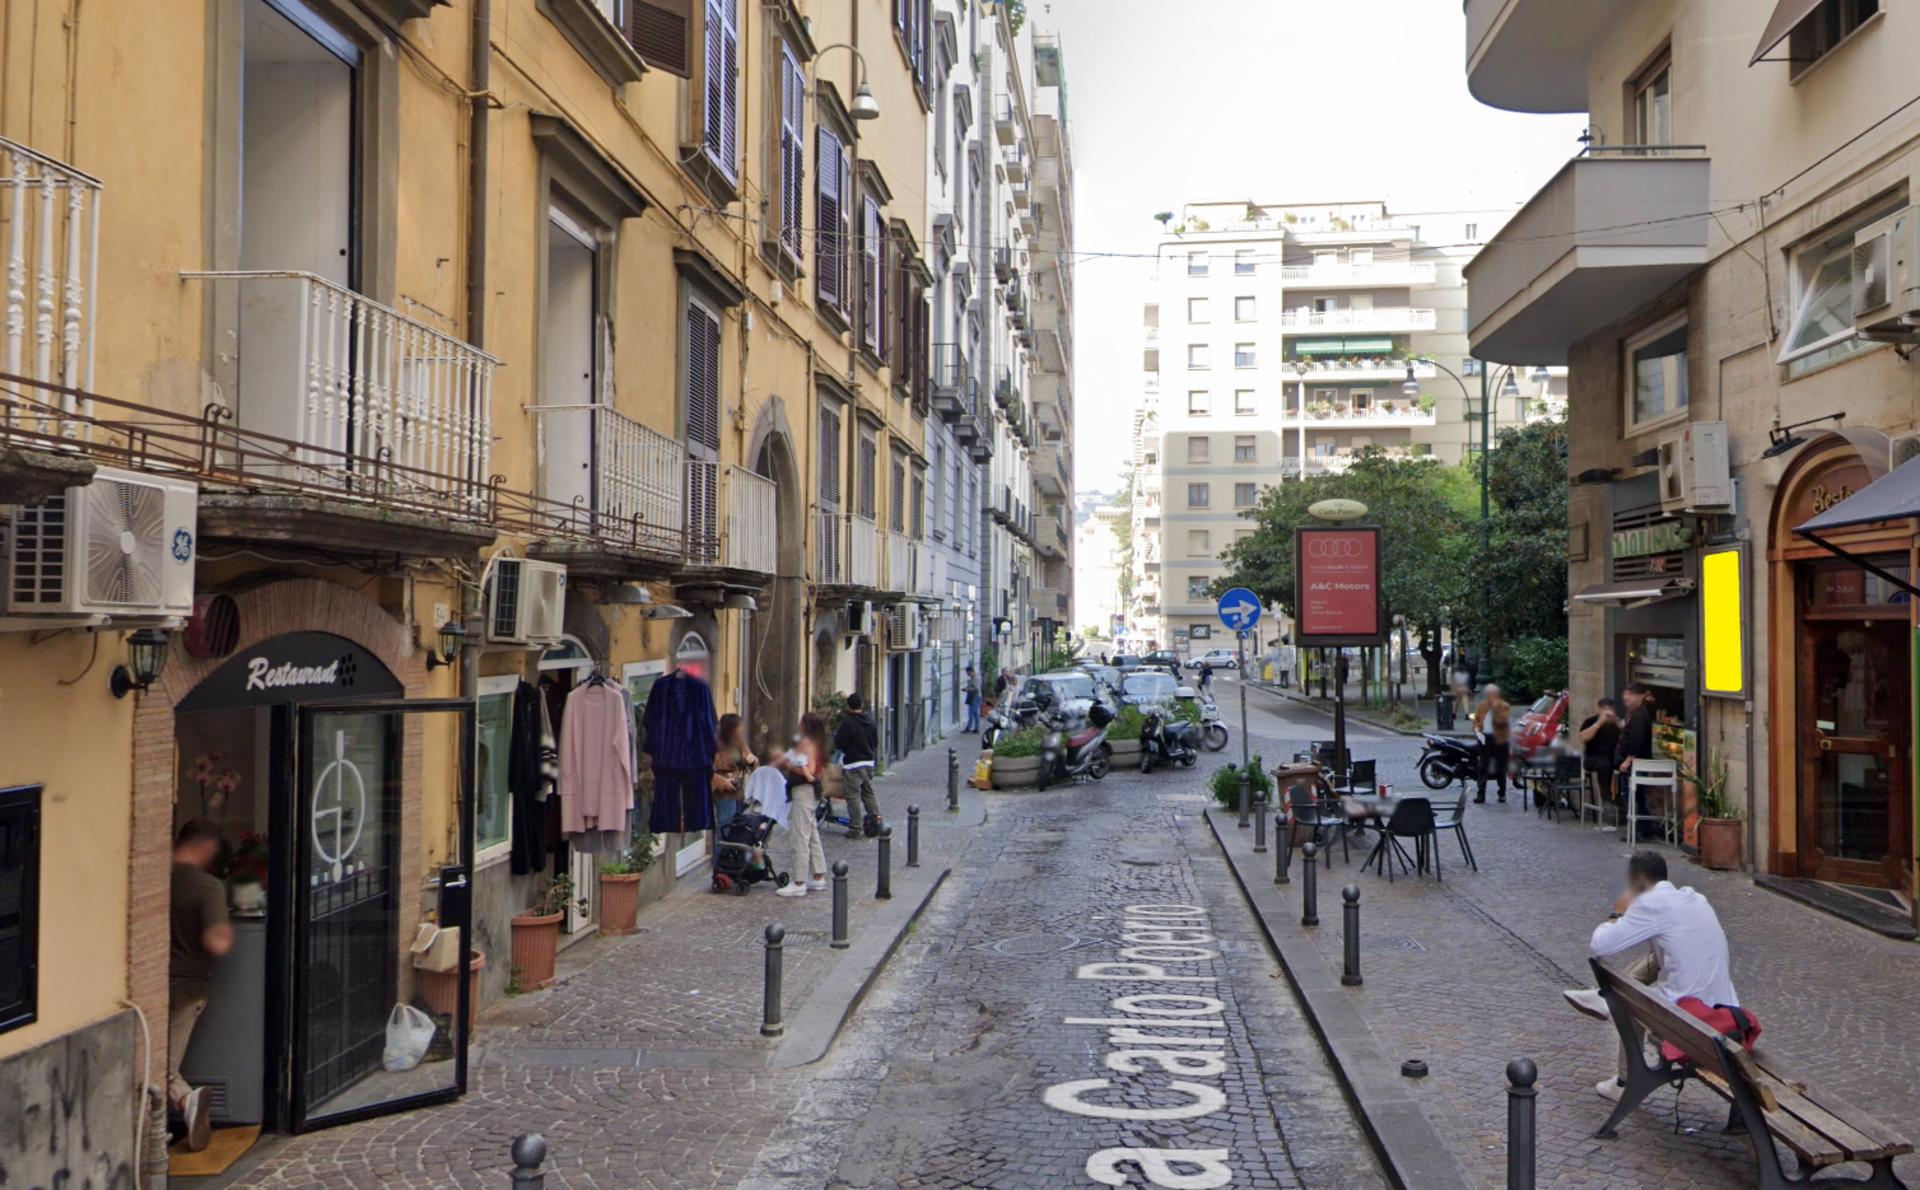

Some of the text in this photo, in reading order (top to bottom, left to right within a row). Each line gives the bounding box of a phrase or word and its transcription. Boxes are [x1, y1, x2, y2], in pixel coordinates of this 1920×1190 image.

[1310, 582, 1371, 591] A&C Motors
[246, 656, 339, 691] Restaurant
